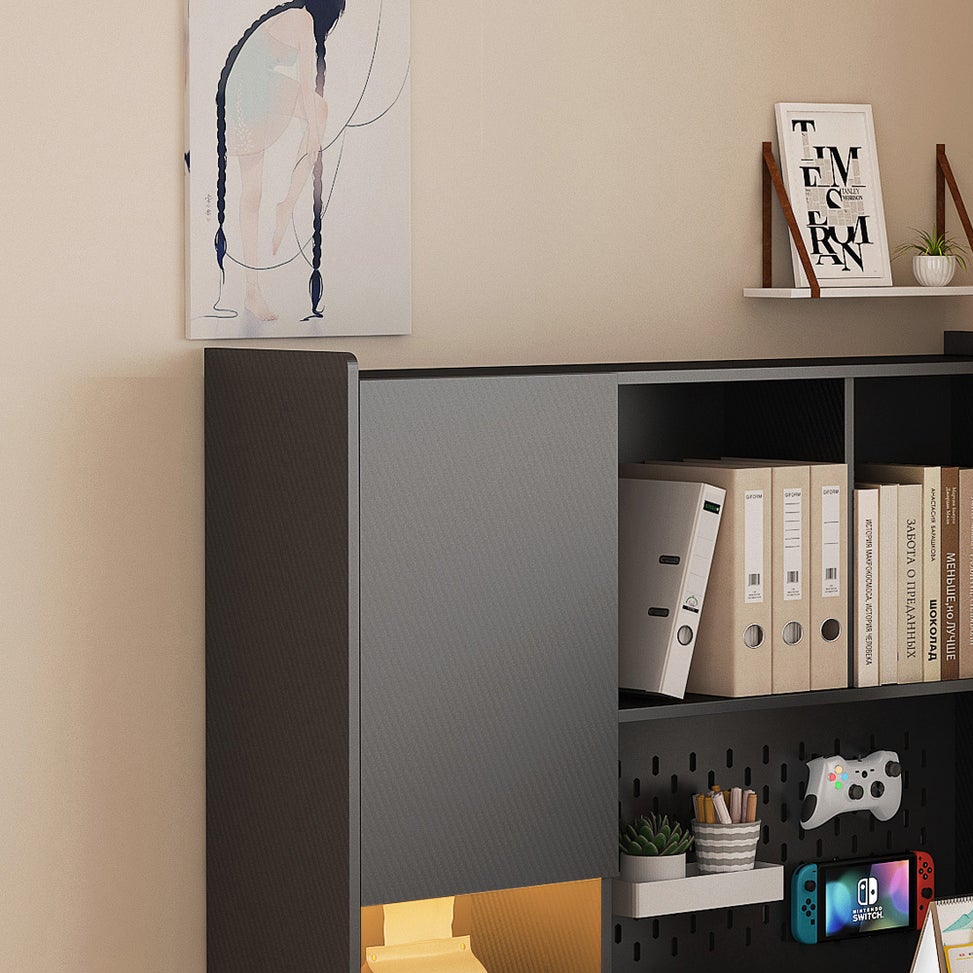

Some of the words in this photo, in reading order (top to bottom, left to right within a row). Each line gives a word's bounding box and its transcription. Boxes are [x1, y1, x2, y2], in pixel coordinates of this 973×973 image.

[905, 518, 916, 565] ЗАБОТА
[906, 569, 916, 578] О
[905, 581, 916, 658] ПРЕДАННЫХ
[928, 599, 937, 662] ШОКОЛАД
[945, 620, 956, 661] ЛУЧШЕ
[852, 905, 883, 914] NINTENDO
[852, 911, 884, 922] SWITCH
